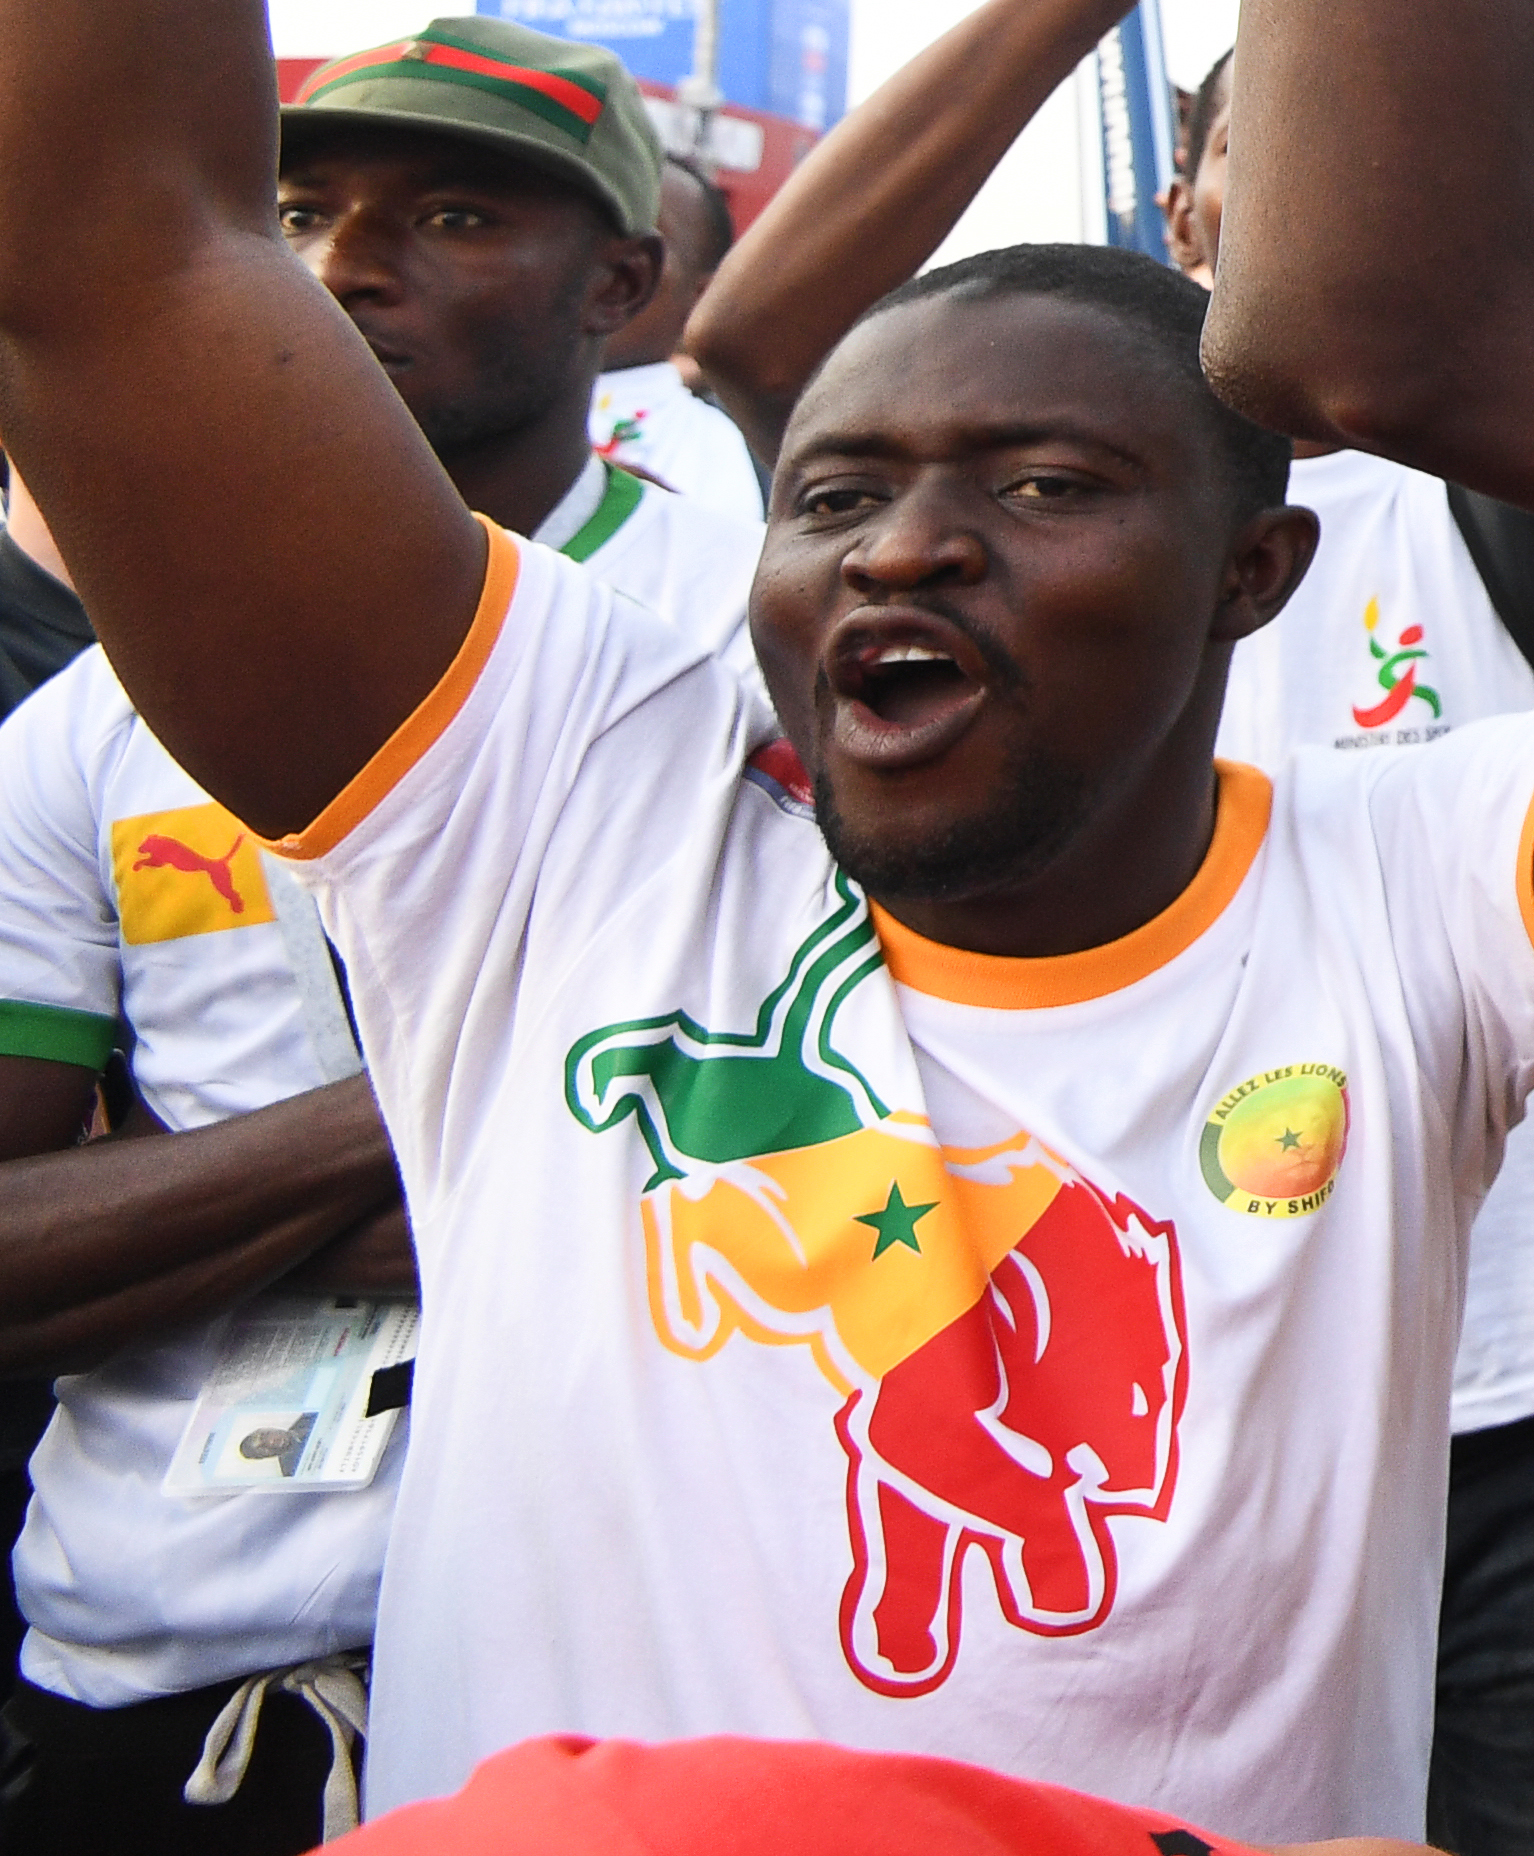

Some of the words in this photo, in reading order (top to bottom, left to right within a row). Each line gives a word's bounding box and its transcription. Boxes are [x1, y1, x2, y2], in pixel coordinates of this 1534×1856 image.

[1215, 1079, 1260, 1120] ALLEZ
[1264, 1065, 1294, 1084] LES
[1301, 1063, 1347, 1088] LIONS
[1247, 1200, 1278, 1215] BY
